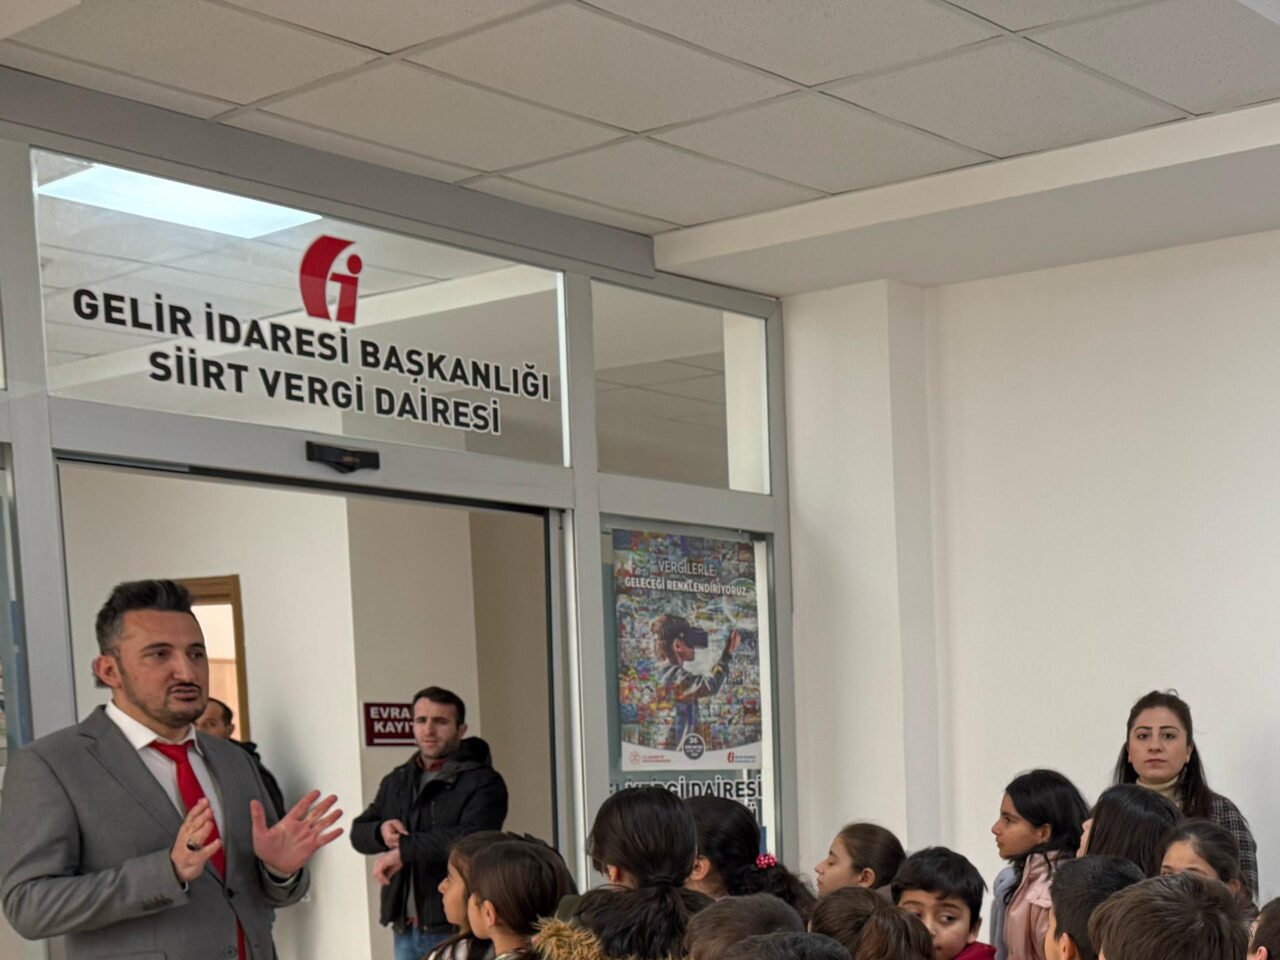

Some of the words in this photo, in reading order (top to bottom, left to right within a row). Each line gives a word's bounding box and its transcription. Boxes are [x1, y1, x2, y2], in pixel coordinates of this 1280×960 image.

[73, 288, 195, 339] GELİR
[205, 302, 349, 364] İDARESİ
[360, 339, 549, 400] BAŞKANLIĞI
[149, 345, 248, 393] SİİRT
[258, 367, 364, 412] VERGİ
[375, 387, 500, 433] DAİRESİ
[658, 558, 714, 576] VERGİLERLE
[624, 576, 665, 590] GELECEĞİ
[370, 706, 411, 719] EVRA
[692, 775, 762, 799] DAİRESİ
